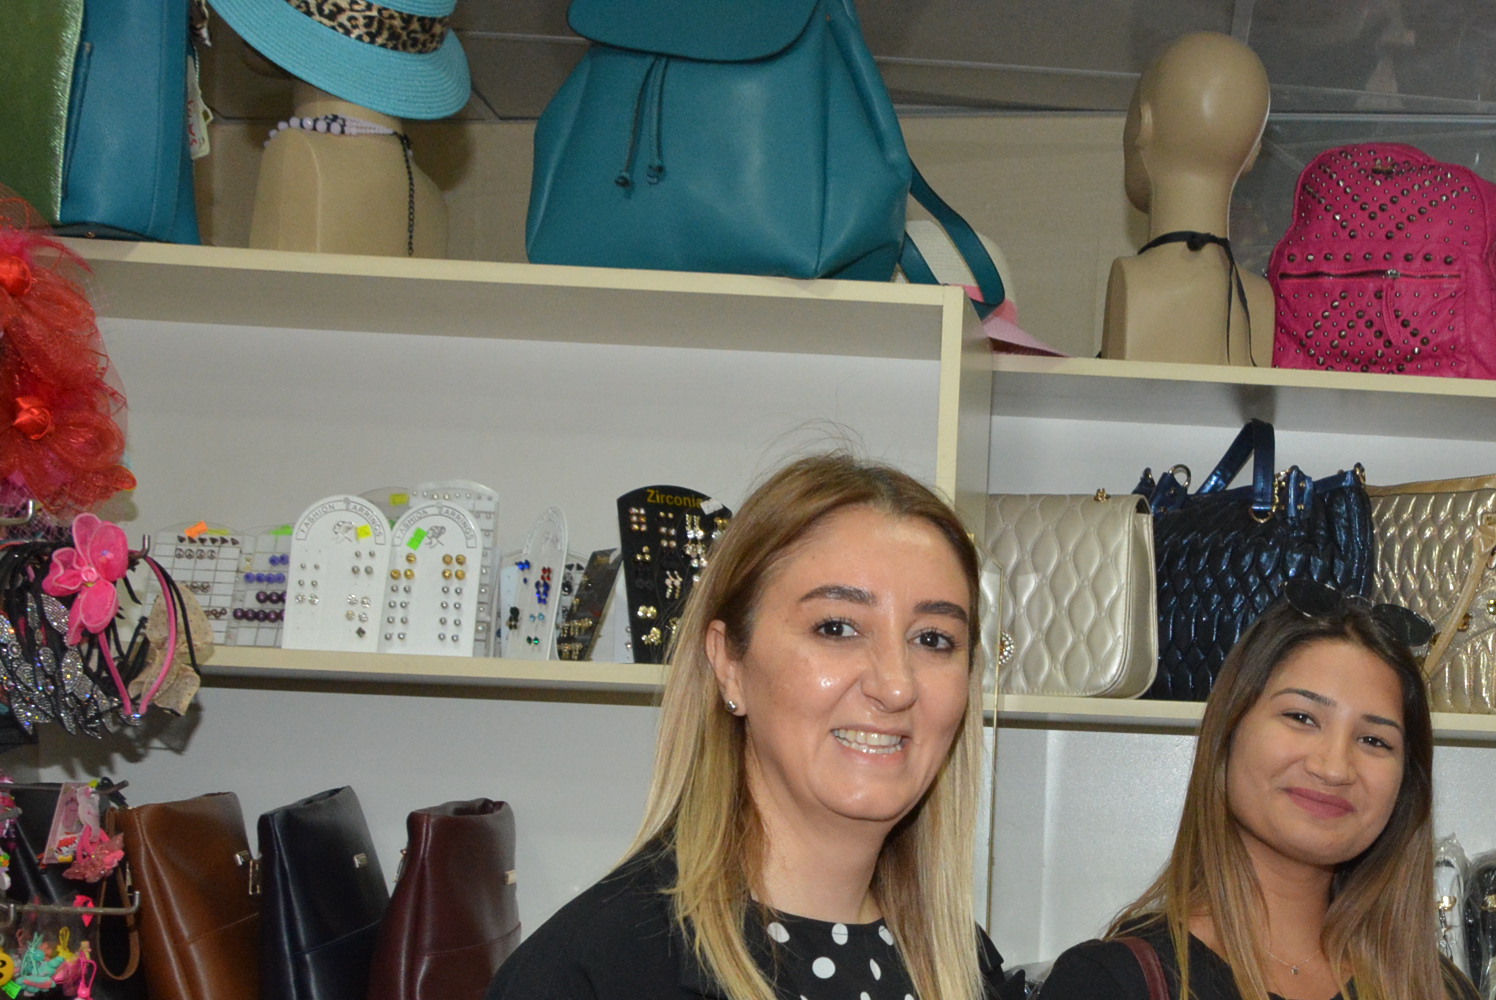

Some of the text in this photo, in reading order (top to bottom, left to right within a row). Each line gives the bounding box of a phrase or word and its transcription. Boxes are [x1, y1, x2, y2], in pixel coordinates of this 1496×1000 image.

[646, 488, 703, 508] Zirconia
[301, 499, 384, 538] FASHION EARRINGS
[437, 504, 475, 541] EARRINGS
